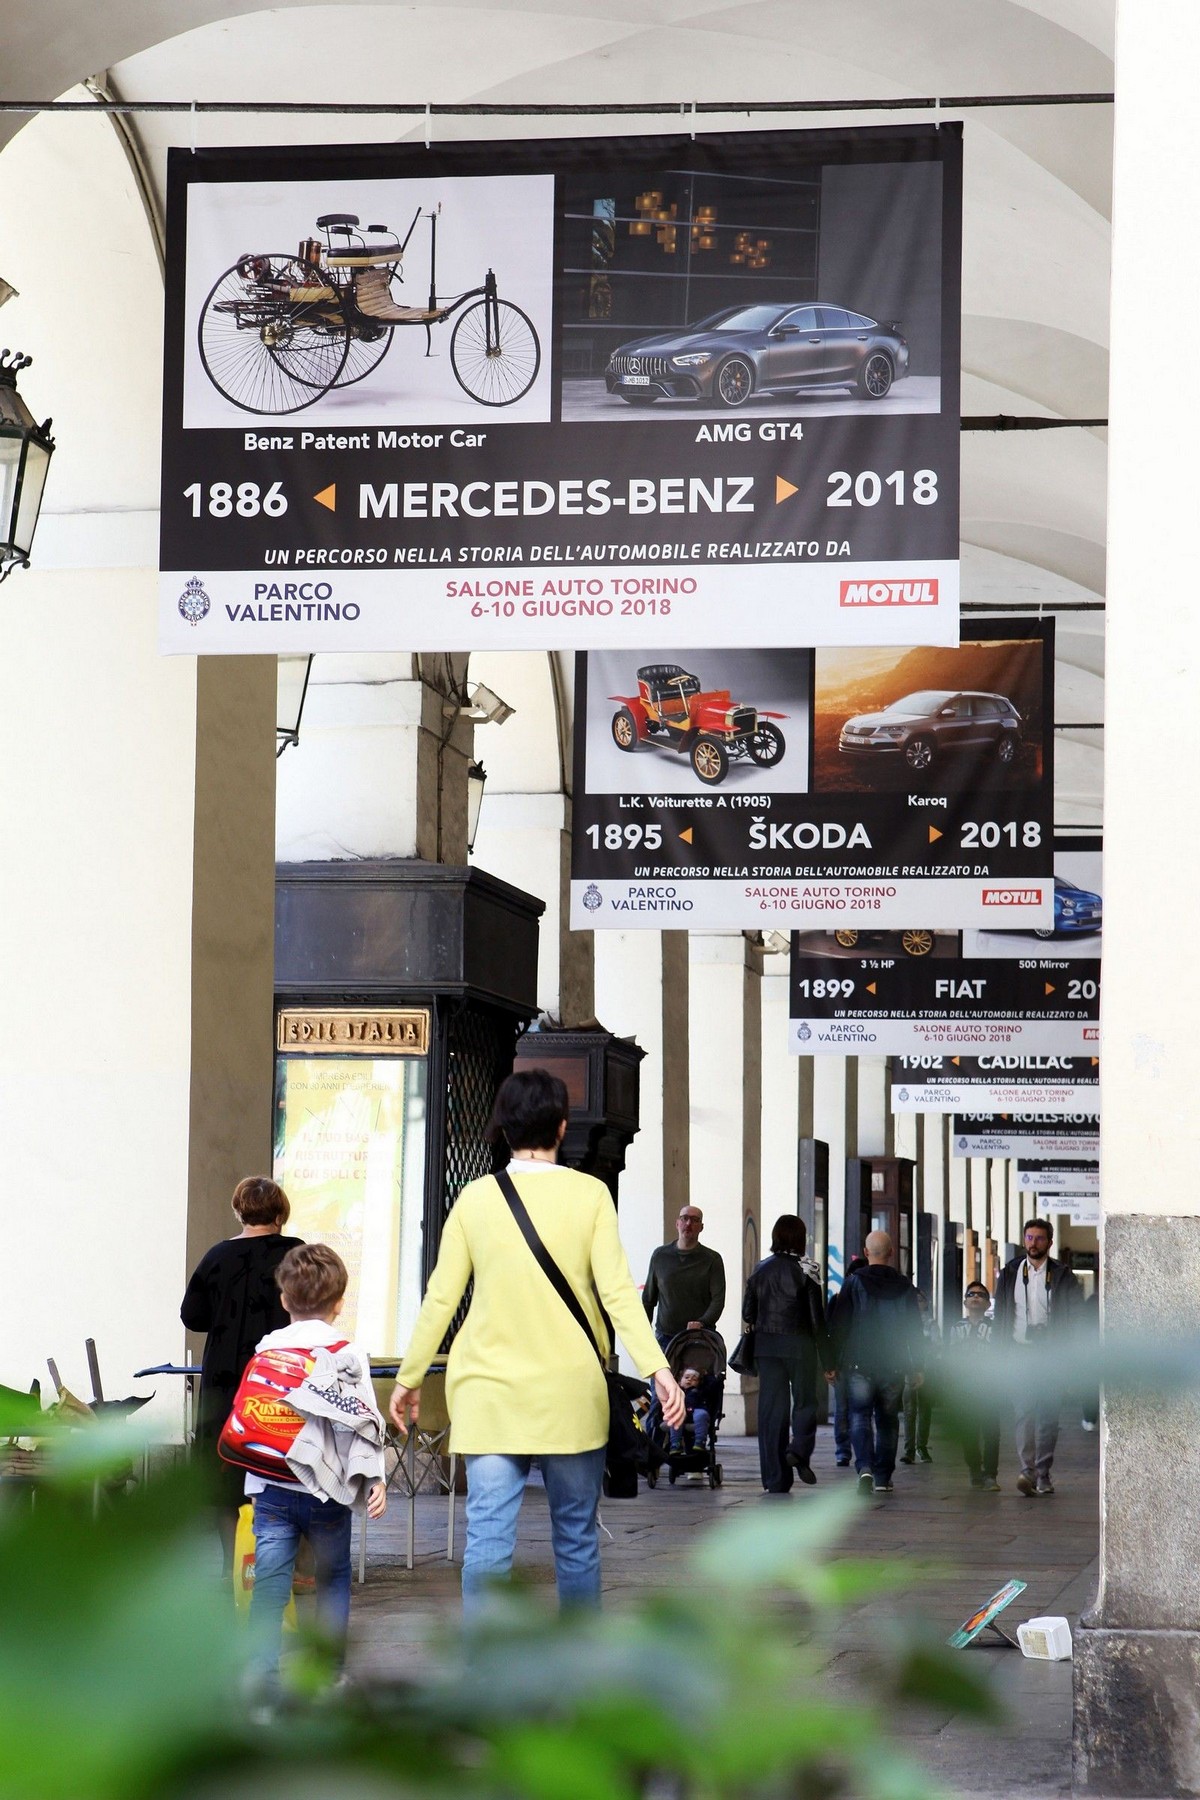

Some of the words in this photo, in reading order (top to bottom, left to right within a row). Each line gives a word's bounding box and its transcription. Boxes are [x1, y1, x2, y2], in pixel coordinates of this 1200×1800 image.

[696, 424, 751, 442] AMG
[759, 423, 803, 440] GT4
[245, 434, 293, 450] Benz
[302, 432, 370, 449] Patent
[378, 432, 443, 448] Motor
[450, 430, 486, 447] Car
[184, 482, 288, 517] 1886
[360, 477, 754, 518] MERCEDES-BENZ
[827, 470, 938, 506] 2018
[265, 550, 289, 564] UN
[295, 549, 387, 564] PERCORSO
[394, 548, 451, 562] NELLA
[458, 547, 522, 562] STORIA
[707, 542, 819, 558] REALIZZATO
[826, 541, 850, 555] DA
[255, 583, 332, 600] PARCO
[446, 581, 533, 597] SALONE
[542, 580, 603, 595] AUTO
[611, 578, 697, 594] TORINO
[844, 581, 937, 604] MOTUL
[226, 603, 360, 621] VALENTINO
[471, 601, 514, 617] 6-10
[522, 600, 613, 616] GIUGNO
[621, 599, 670, 615] 2018
[620, 797, 643, 807] L.K.
[648, 796, 712, 807] Voiturette
[717, 796, 726, 807] A
[731, 796, 771, 808] (1905)
[908, 795, 946, 808] Karoq
[586, 824, 662, 849] 1895
[749, 816, 872, 849] ŠKODA
[961, 822, 1041, 848] 2018
[635, 867, 650, 876] UN
[653, 867, 709, 876] PERCORSO
[714, 867, 748, 876] NELLA
[752, 867, 791, 876] STORIA
[902, 866, 970, 875] REALIZZATO
[974, 866, 988, 875] DA
[629, 888, 676, 898] PARCO
[745, 888, 798, 897] SALONE
[803, 887, 840, 897] AUTO
[844, 887, 896, 896] TORINO
[985, 891, 1040, 904] MOTUL
[612, 900, 693, 910] VALENTINO
[760, 900, 786, 909] 6-10
[791, 900, 846, 909] GIUGNO
[851, 900, 880, 909] 2018
[860, 960, 867, 969] 3
[880, 960, 895, 969] HP
[1019, 960, 1037, 969] 500
[1039, 960, 1070, 969] Mirror
[800, 980, 854, 998] 1899
[936, 980, 986, 998] FIAT
[1067, 979, 1101, 1000] 20
[834, 1010, 846, 1018] UN
[847, 1010, 889, 1018] PERCORSO
[890, 1010, 916, 1018] NELLA
[918, 1010, 947, 1018] STORIA
[1025, 1011, 1075, 1019] REALIZZATO
[1077, 1011, 1088, 1019] DA
[290, 1022, 336, 1041] EDIL
[346, 1021, 418, 1041] ITALIA
[829, 1025, 865, 1033] PARCO
[913, 1025, 952, 1033] SALONE
[954, 1025, 983, 1033] AUTO
[984, 1026, 1023, 1034] TORINO
[817, 1034, 877, 1043] VALENTINO
[923, 1034, 944, 1042] 6-10
[946, 1034, 987, 1043] GIUGNO
[988, 1034, 1011, 1043] 2018
[899, 1056, 943, 1069] 1902
[978, 1056, 1073, 1069] CADILLAC
[914, 1095, 960, 1103] VALENTINO
[997, 1095, 1013, 1103] 6-10
[1014, 1095, 1046, 1103] GIUGNO
[1044, 1089, 1074, 1097] TORINO
